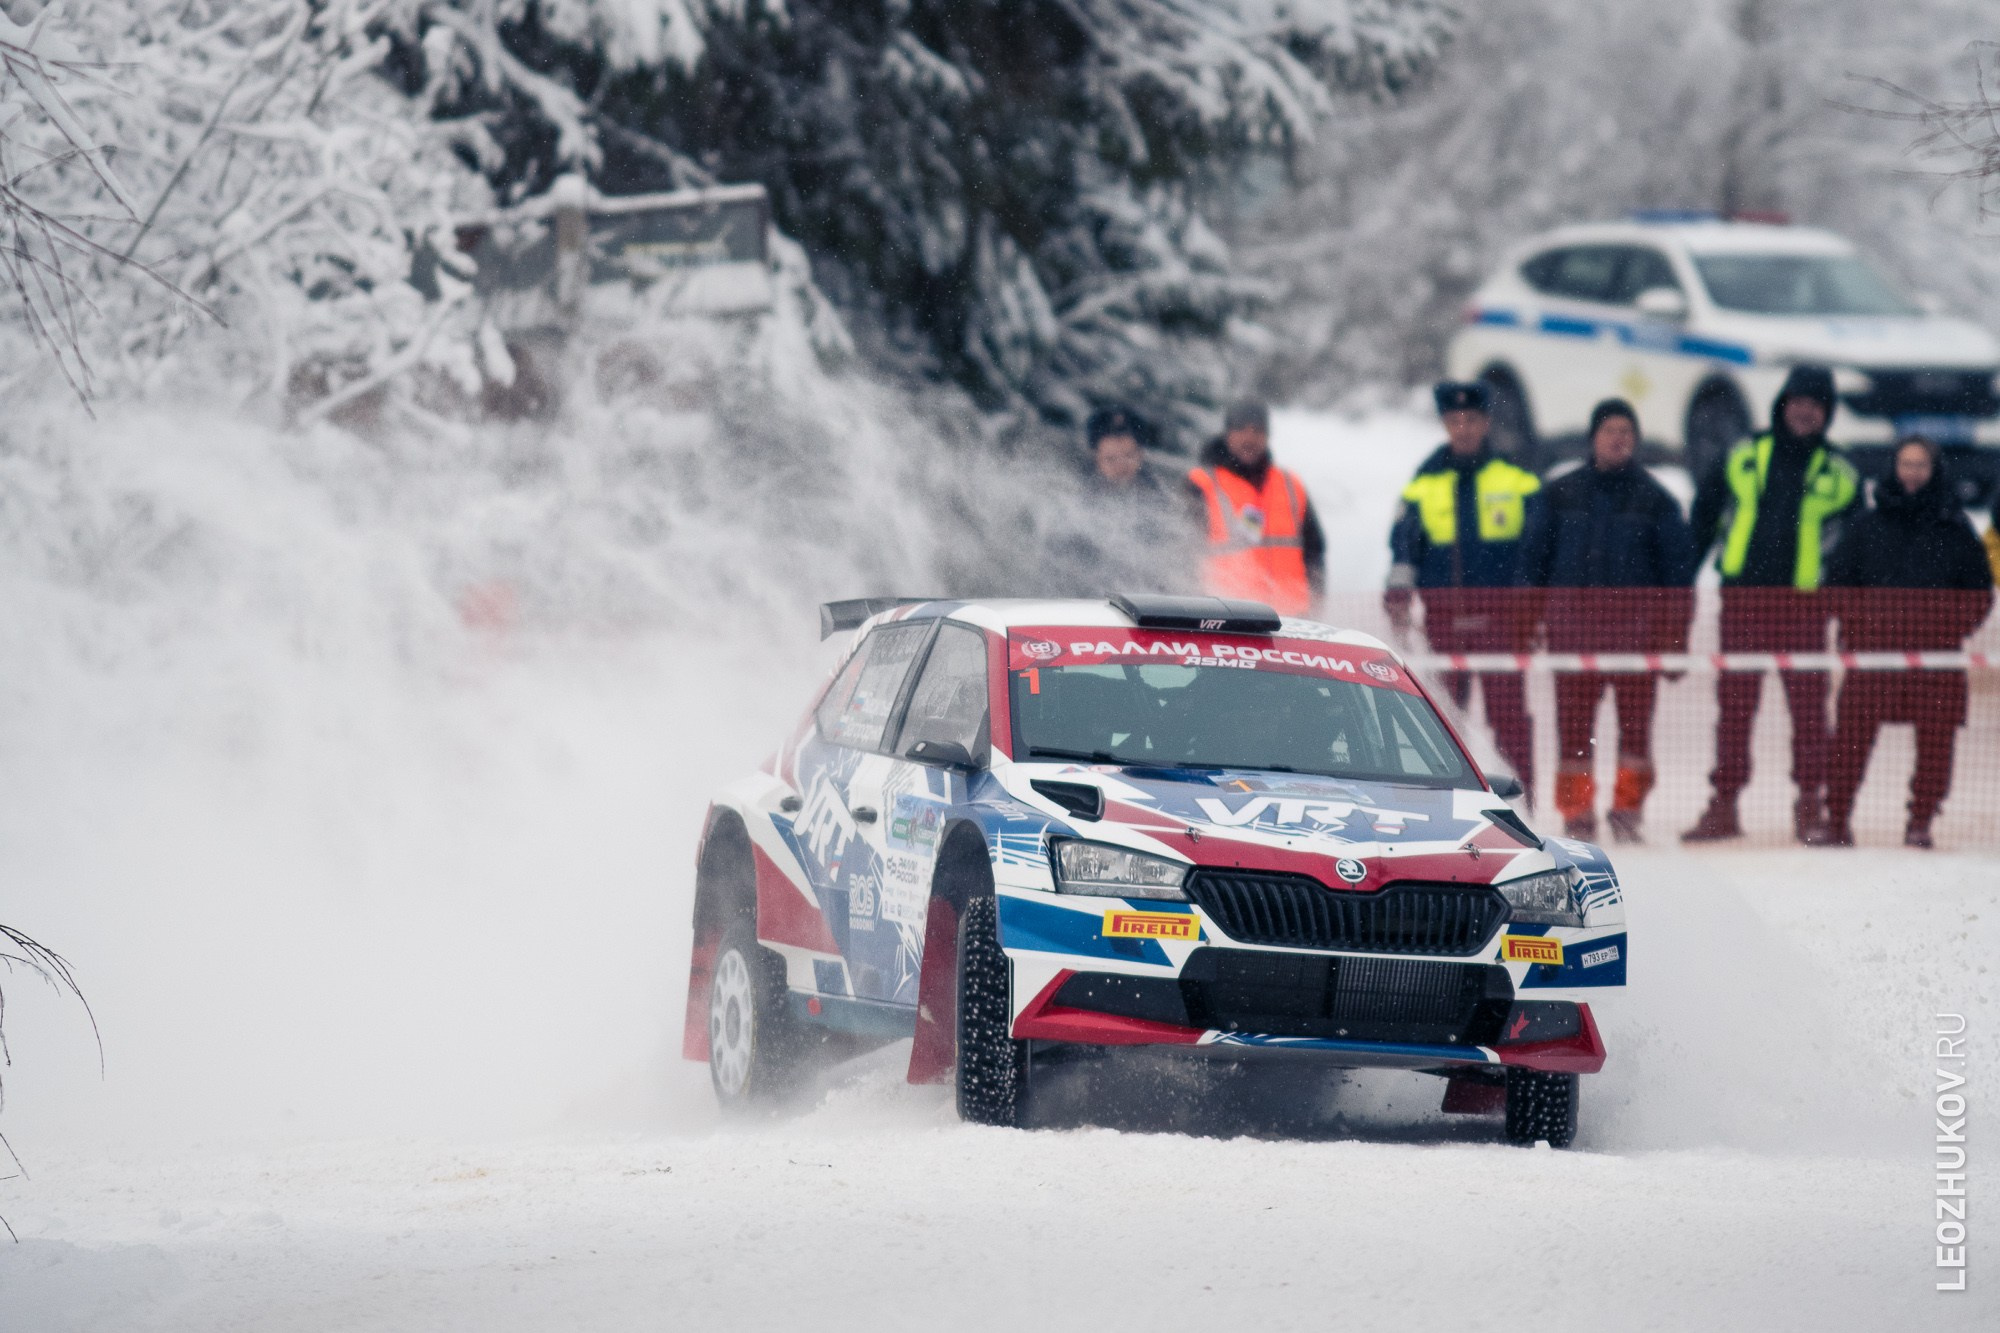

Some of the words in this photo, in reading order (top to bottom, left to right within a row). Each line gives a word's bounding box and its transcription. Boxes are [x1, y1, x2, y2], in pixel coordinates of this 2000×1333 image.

[1200, 619, 1226, 630] VRT
[1070, 641, 1200, 656] РАЛЛИ
[1211, 644, 1355, 673] РОССИИ
[1184, 655, 1256, 669] ASMG
[1019, 667, 1040, 694] 1
[1194, 797, 1430, 835] VRT
[849, 873, 875, 916] ROS
[1112, 914, 1191, 936] PIRELLI
[1508, 939, 1558, 960] PIRELLI
